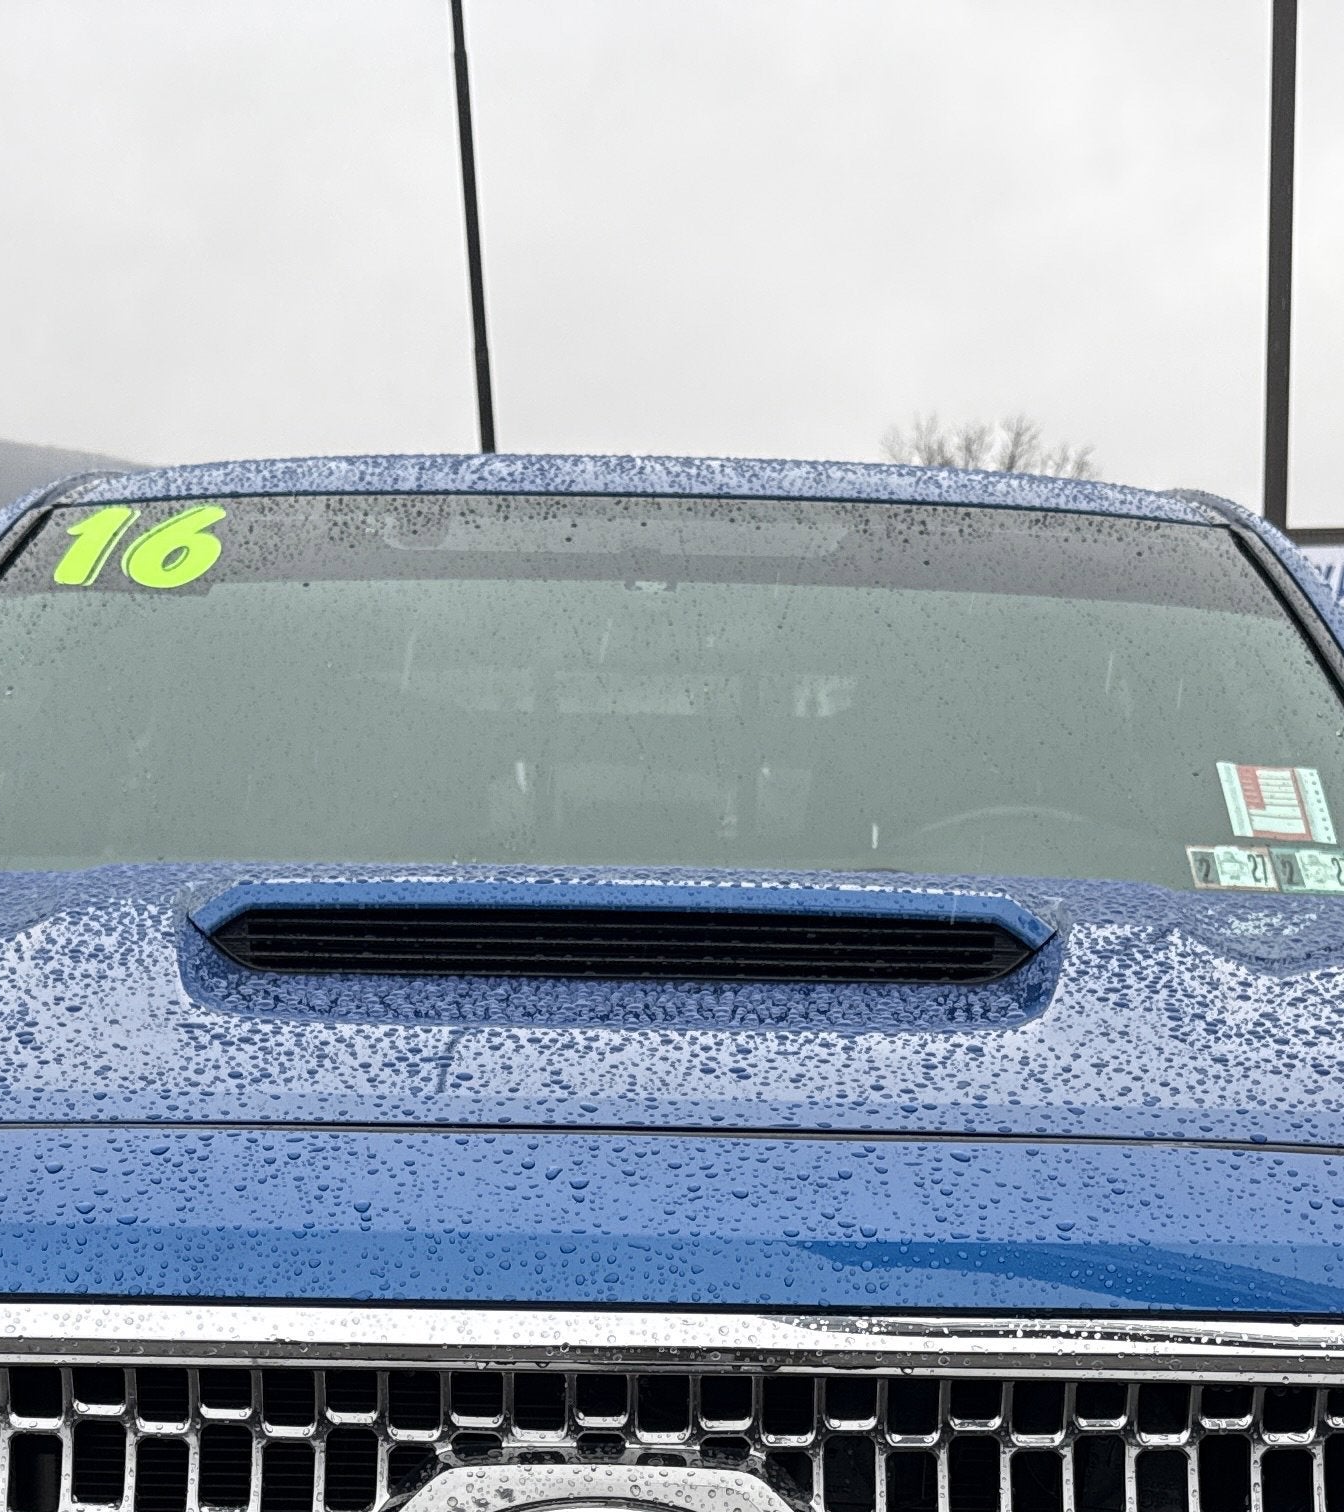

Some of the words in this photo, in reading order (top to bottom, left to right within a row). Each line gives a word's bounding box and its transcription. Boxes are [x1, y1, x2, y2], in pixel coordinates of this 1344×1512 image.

[53, 504, 226, 588] 16
[1198, 857, 1214, 884] 2
[1248, 854, 1268, 885] 27
